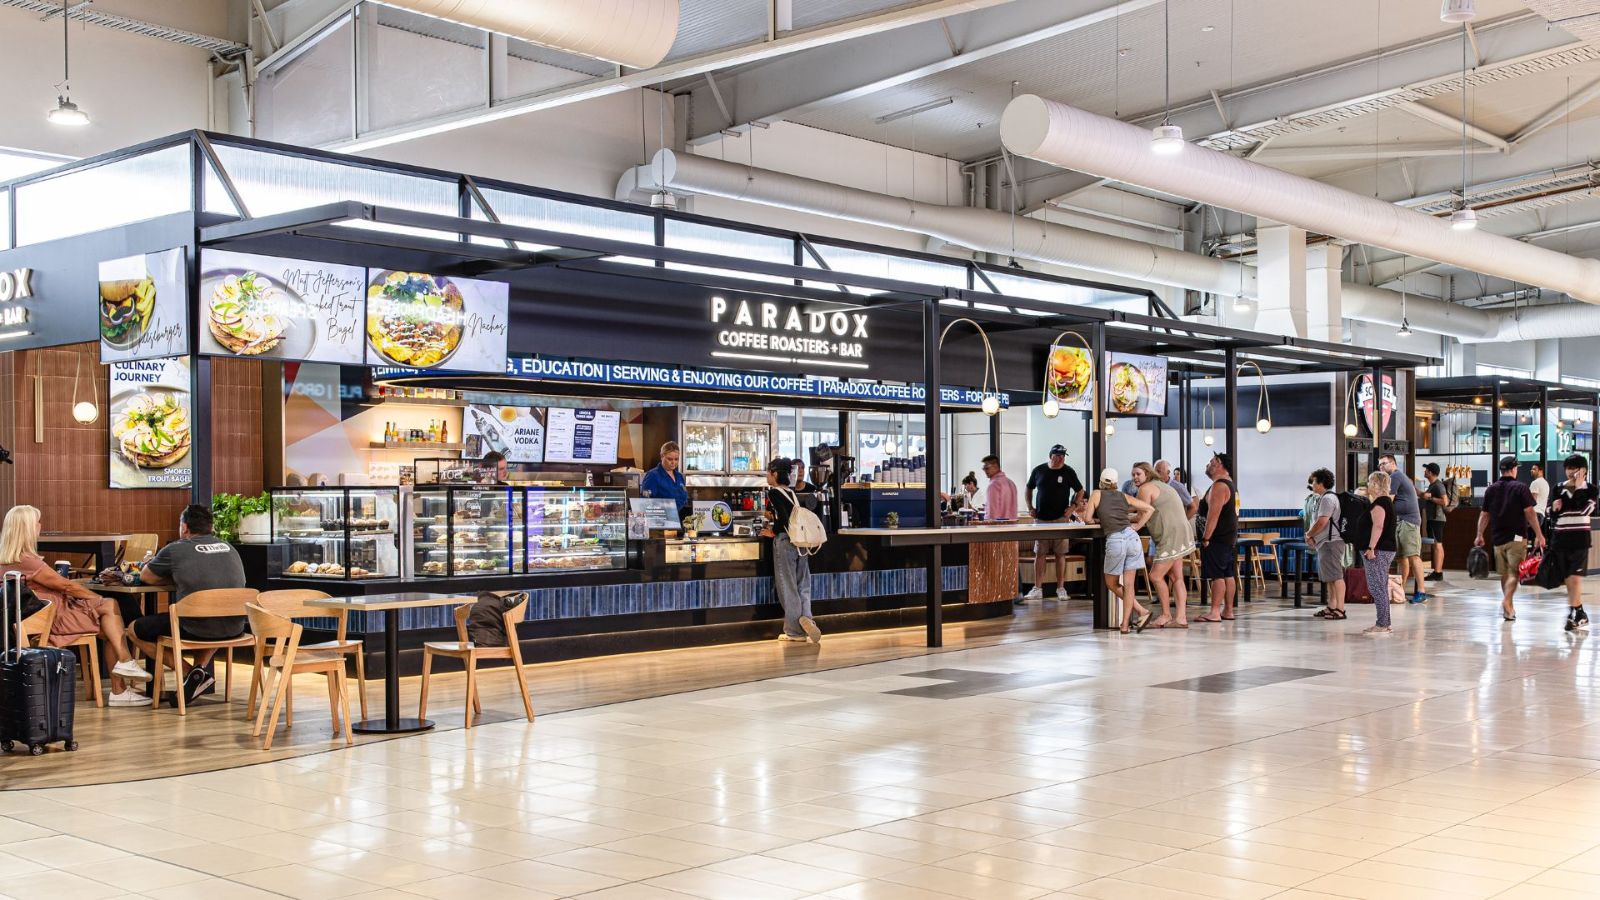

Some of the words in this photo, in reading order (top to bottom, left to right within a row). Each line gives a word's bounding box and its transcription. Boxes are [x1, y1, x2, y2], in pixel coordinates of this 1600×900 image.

[313, 270, 364, 294] Jefferson's
[333, 292, 363, 317] Trout
[468, 313, 507, 337] Nachos
[710, 296, 868, 338] PARADOX
[327, 318, 357, 344] Bagel
[718, 331, 768, 349] COFFEE
[770, 336, 829, 355] ROASTERS
[830, 345, 838, 353] +
[839, 343, 863, 358] BAR
[114, 372, 162, 383] JOURNEY
[115, 362, 166, 372] CULINARY
[522, 358, 603, 378] EDUCATION
[613, 365, 669, 382] SERVING
[671, 369, 680, 383] &
[683, 370, 742, 387] ENJOYING
[744, 375, 769, 389] OUR
[771, 377, 814, 392] COFFEE
[823, 382, 871, 396] PARADOX
[872, 386, 910, 399] COFFEE
[912, 387, 959, 401] ROTERS
[965, 391, 983, 402] FOR
[514, 437, 539, 445] VODKA
[515, 428, 540, 436] ARIANE
[1560, 432, 1570, 453] 12
